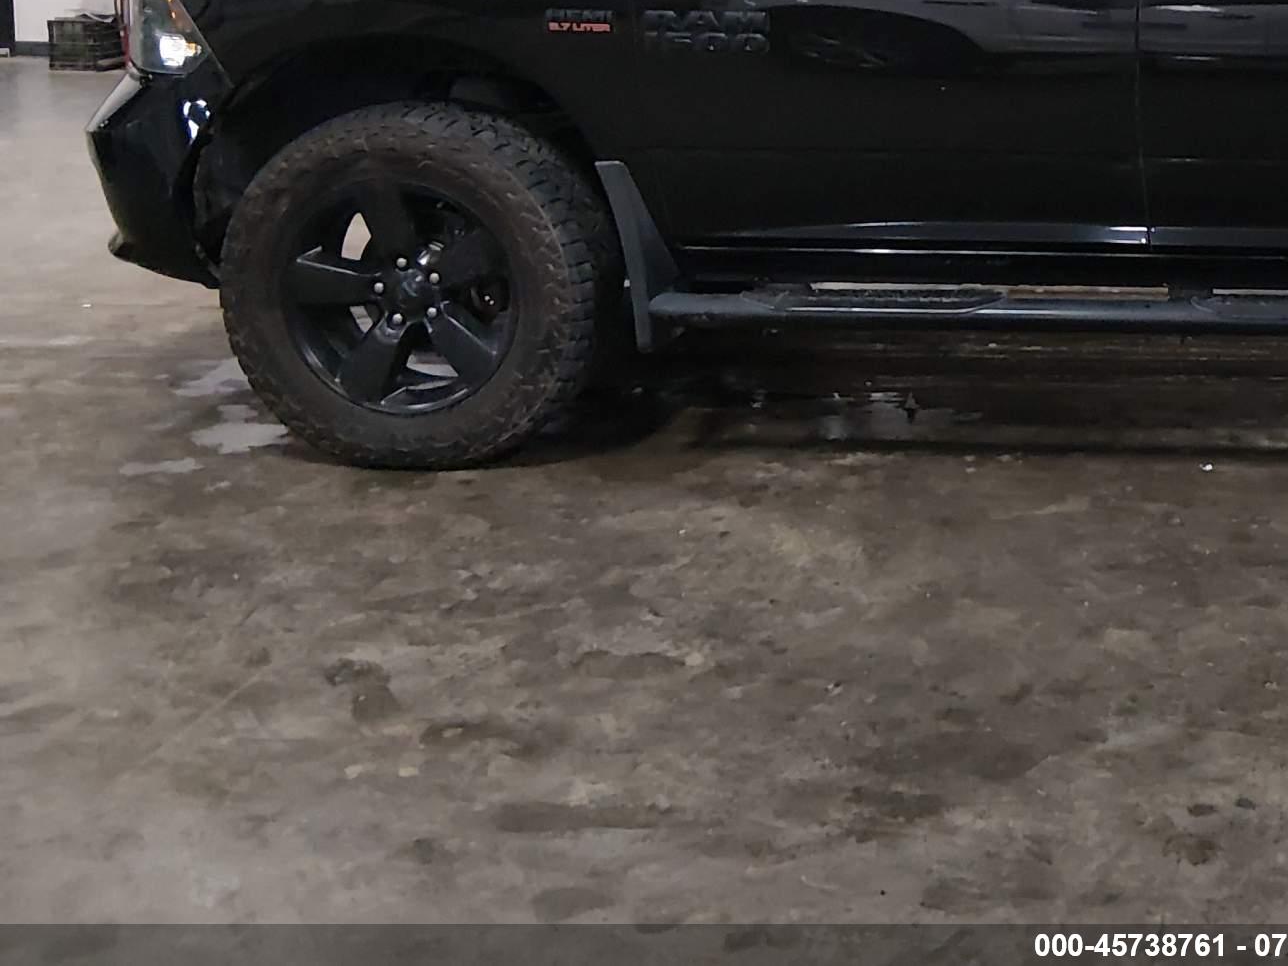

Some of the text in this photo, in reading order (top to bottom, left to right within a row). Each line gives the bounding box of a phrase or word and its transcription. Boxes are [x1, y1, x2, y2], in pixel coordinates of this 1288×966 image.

[548, 22, 611, 32] 5.7 LITER
[641, 10, 770, 31] RAM
